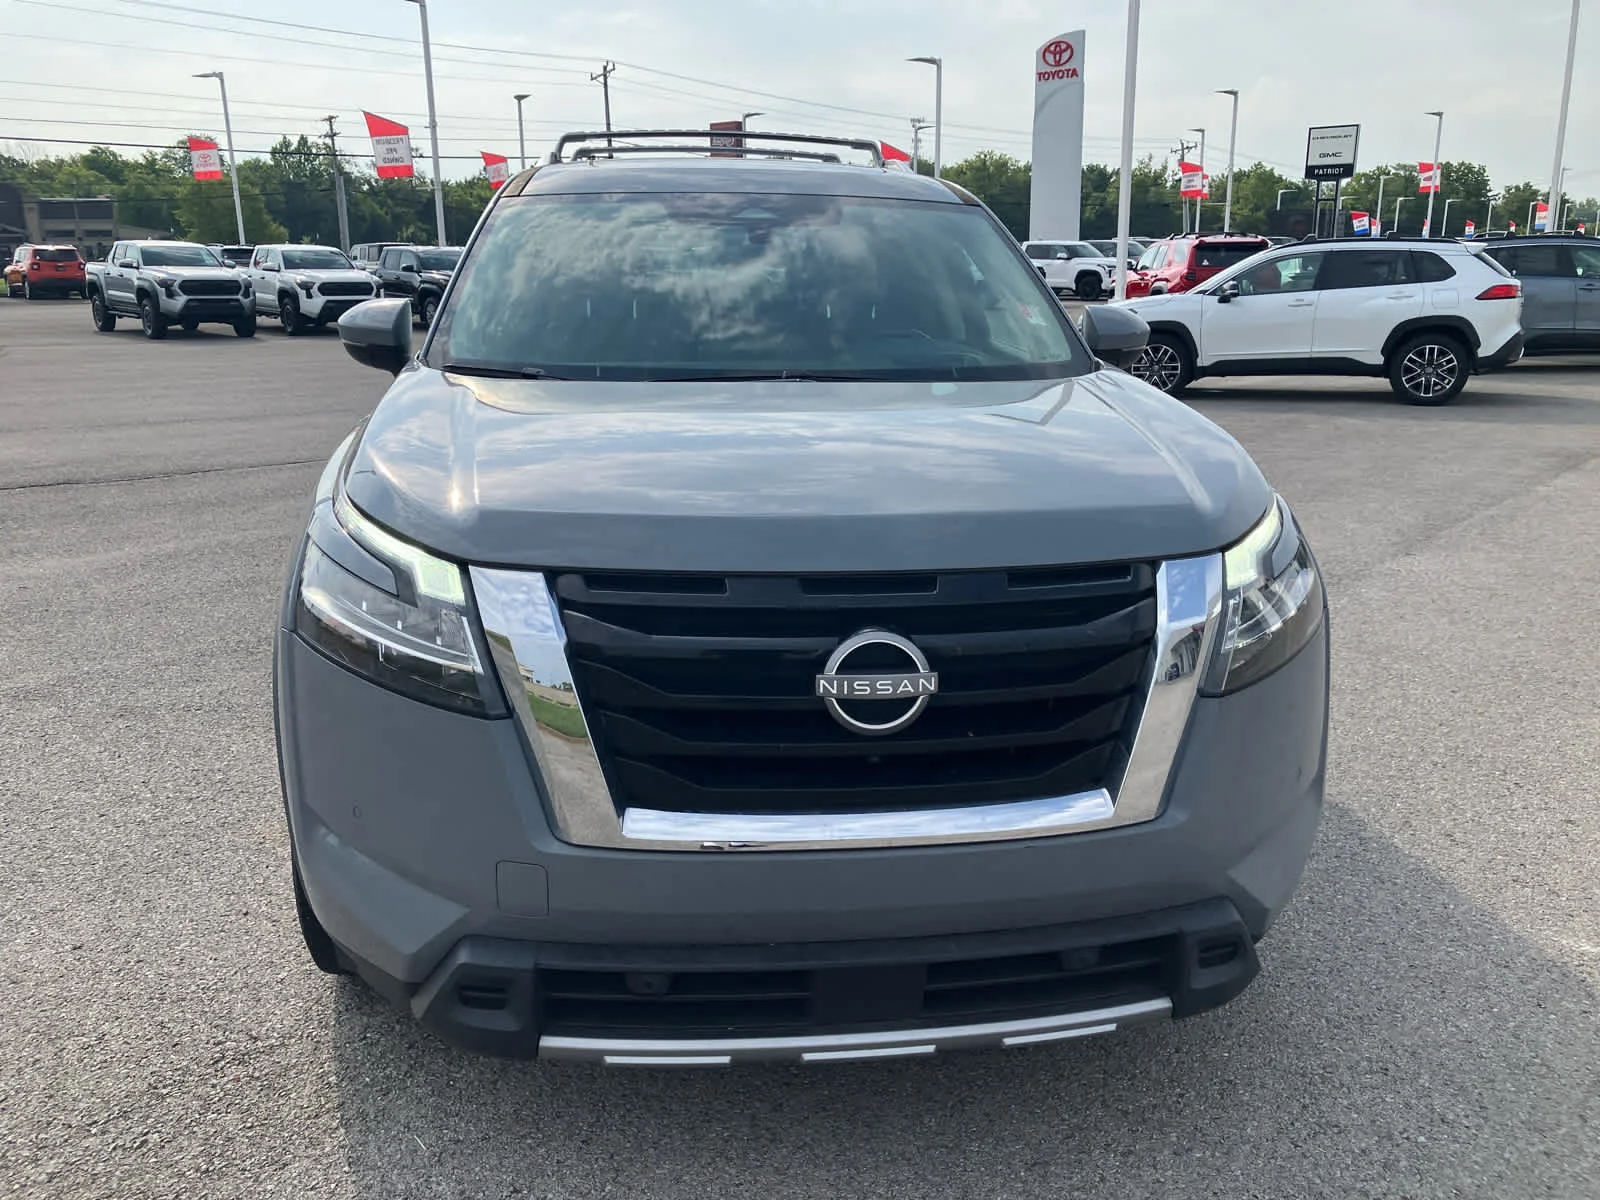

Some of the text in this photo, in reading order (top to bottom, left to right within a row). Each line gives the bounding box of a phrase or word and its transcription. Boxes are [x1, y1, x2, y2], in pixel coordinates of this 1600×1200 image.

[1036, 67, 1079, 82] TOYOTA
[1314, 167, 1344, 175] PATRIOT
[819, 676, 936, 695] NISSAN
